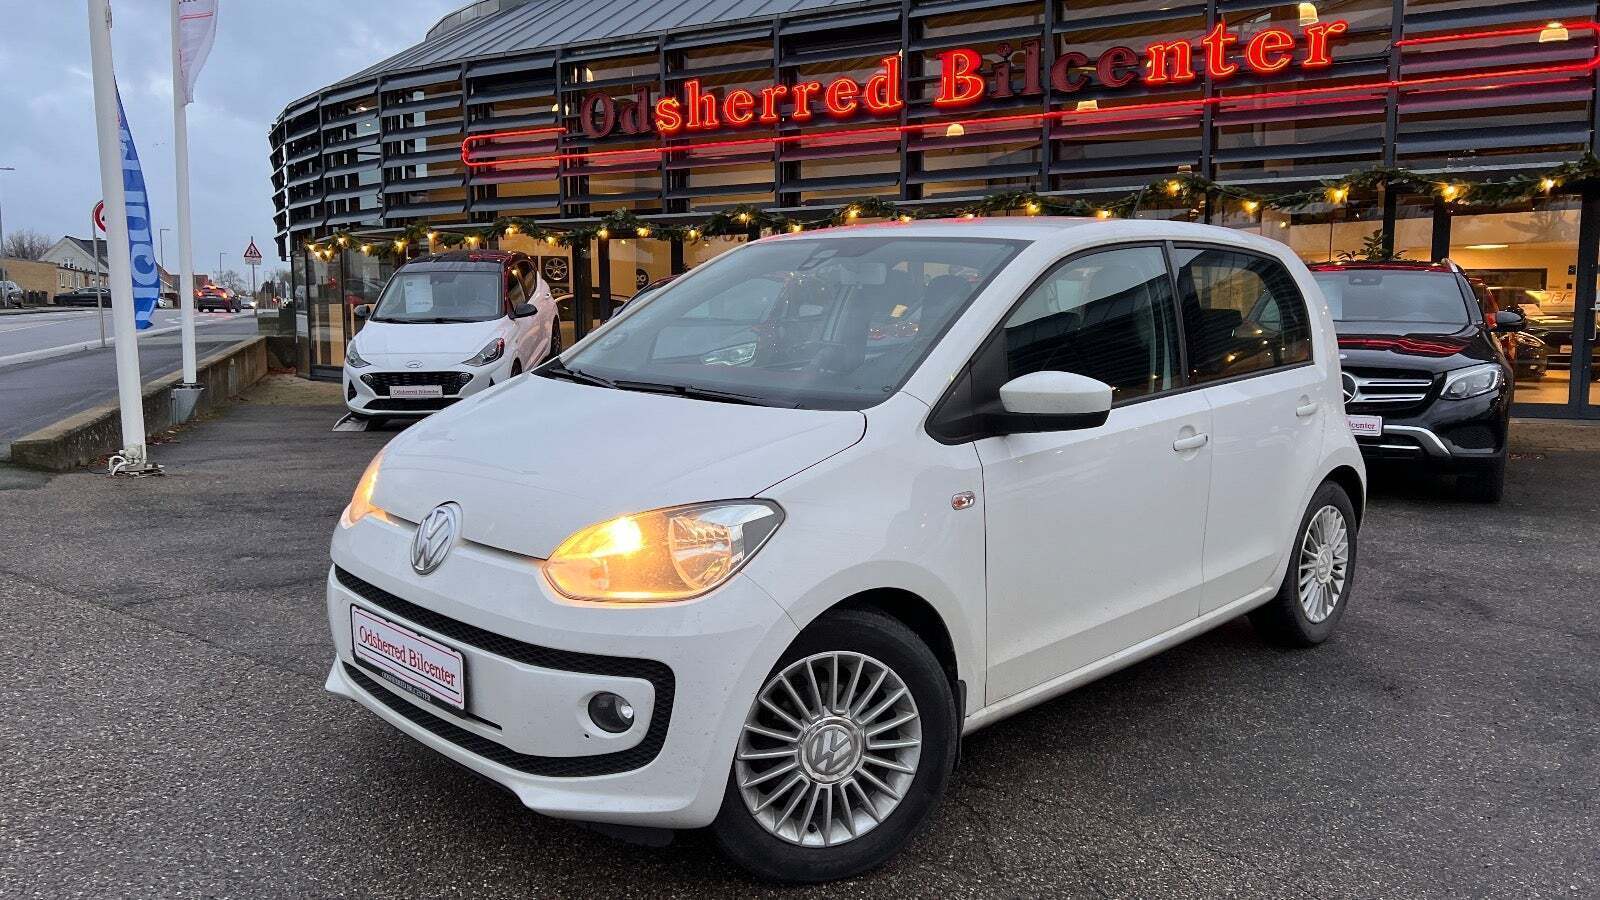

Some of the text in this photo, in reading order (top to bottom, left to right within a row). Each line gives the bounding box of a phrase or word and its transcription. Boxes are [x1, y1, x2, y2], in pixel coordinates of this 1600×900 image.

[579, 20, 1347, 138] Odsherred Bilcenter
[359, 626, 456, 686] Odsherred Bilcenter
